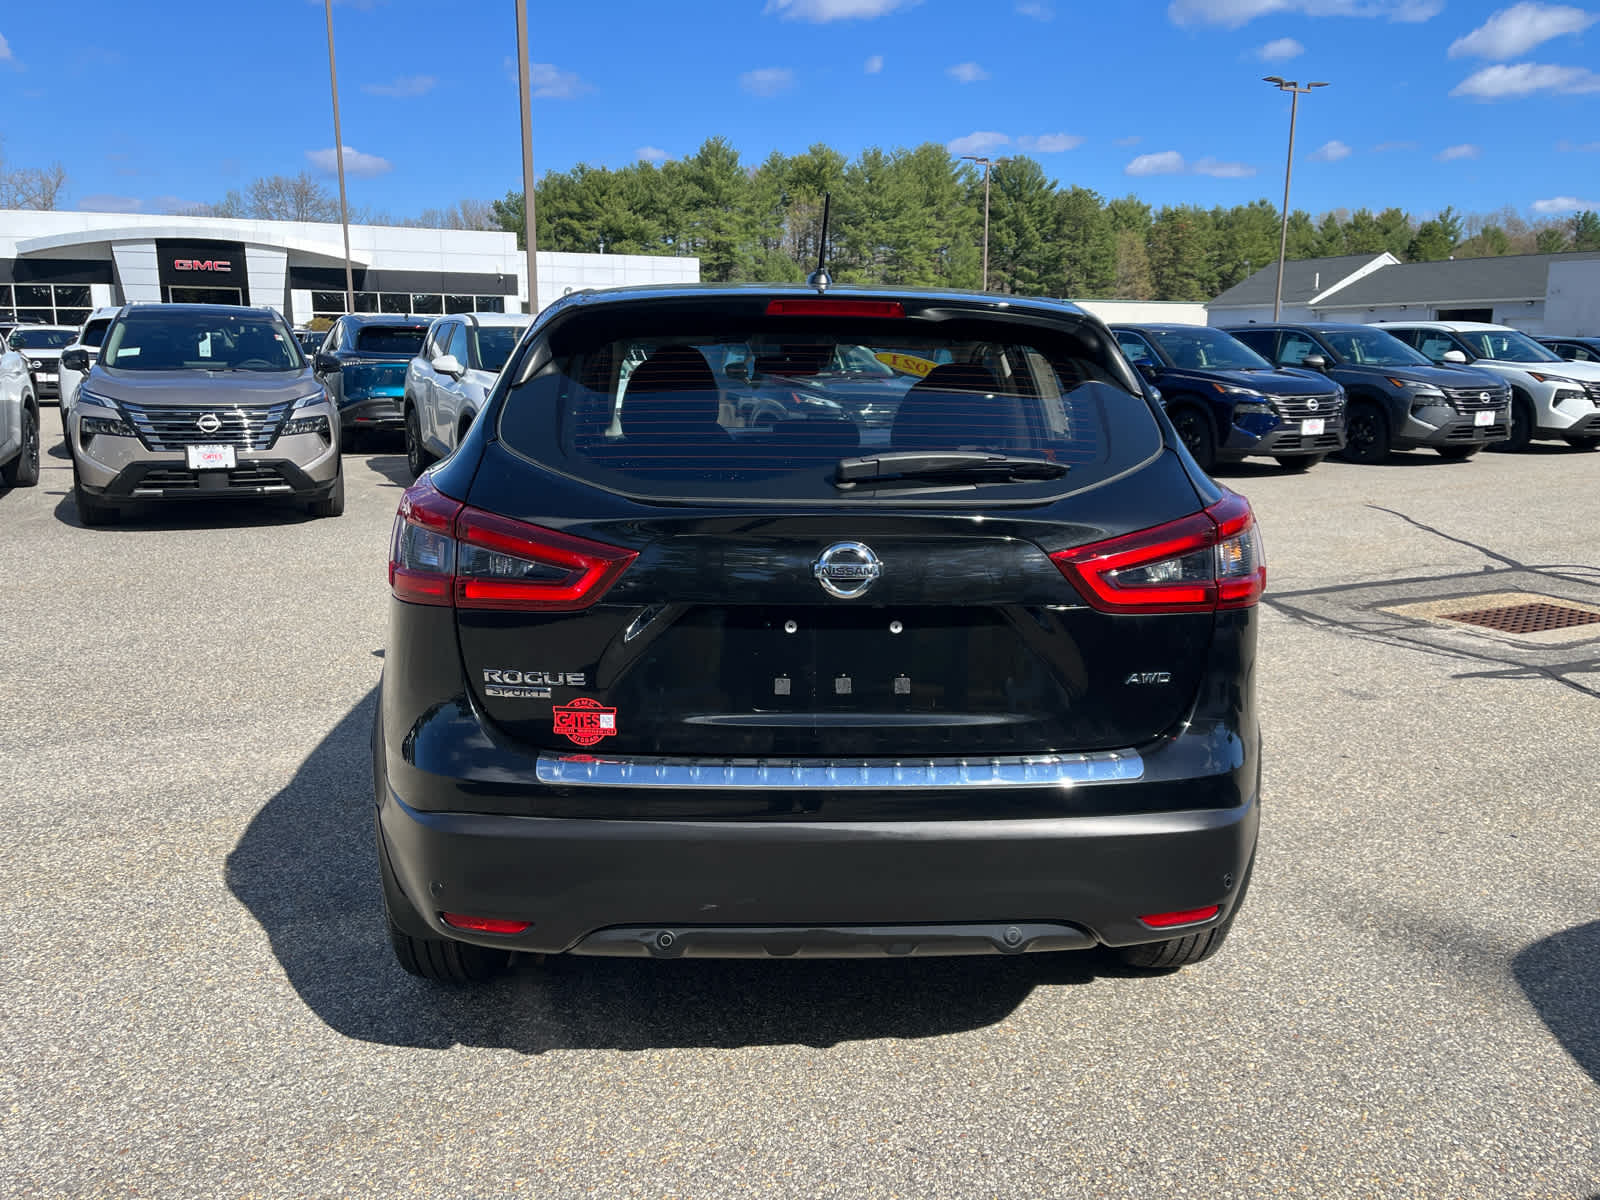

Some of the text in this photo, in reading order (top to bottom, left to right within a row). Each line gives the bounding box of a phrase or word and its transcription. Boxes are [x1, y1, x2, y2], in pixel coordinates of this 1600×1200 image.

[174, 259, 231, 271] GMC
[821, 566, 873, 576] NISSAN
[483, 669, 586, 686] ROGUE
[1125, 671, 1171, 684] AWD
[489, 687, 546, 698] SPORT
[557, 712, 600, 728] GATES
